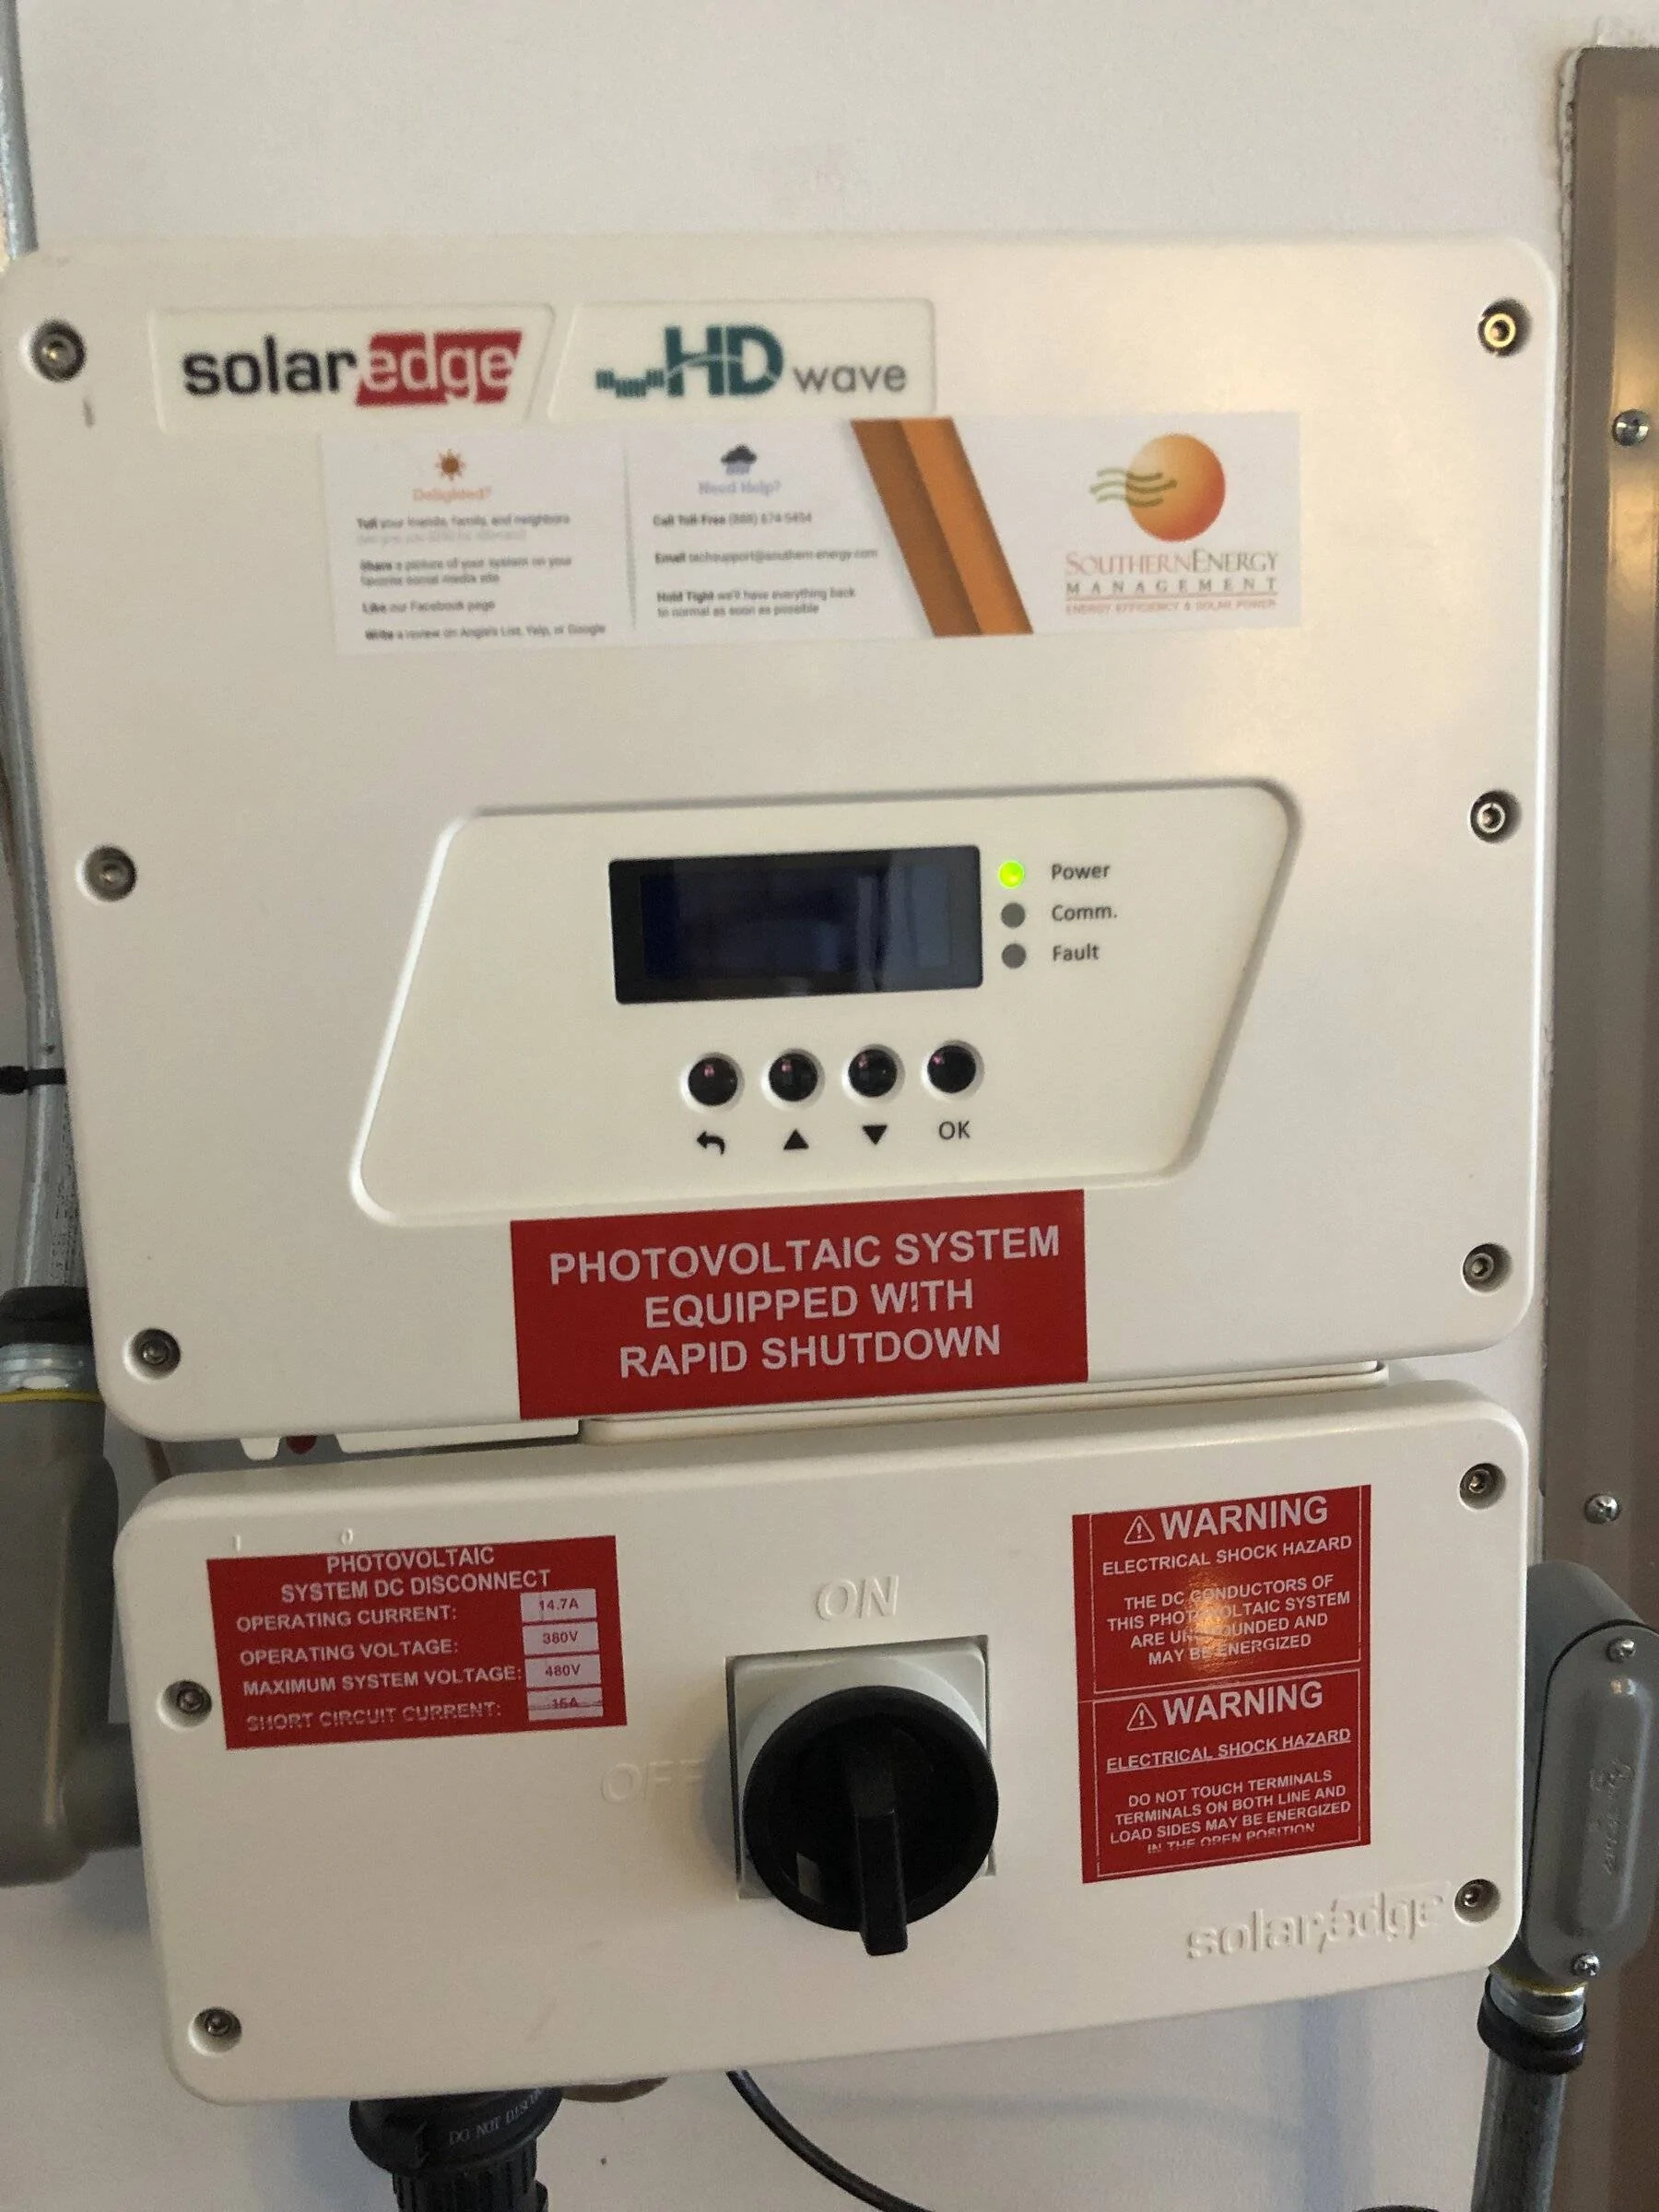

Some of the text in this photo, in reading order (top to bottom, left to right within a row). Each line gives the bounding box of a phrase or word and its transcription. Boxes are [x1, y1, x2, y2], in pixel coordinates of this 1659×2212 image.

[182, 332, 522, 403] solaredge
[664, 323, 907, 397] HD wave
[699, 479, 782, 497] Need Help?
[381, 519, 404, 530] your
[490, 514, 512, 527] and
[653, 513, 675, 526] Call
[446, 558, 458, 570] of
[655, 551, 686, 564] Email
[657, 591, 683, 603] Hold
[688, 590, 713, 604] Tight
[744, 590, 769, 601] have
[772, 588, 827, 602] everything
[830, 587, 855, 599] back
[1065, 577, 1277, 595] MANAGEMENT
[410, 600, 464, 612] Facebook
[467, 600, 495, 613] page
[658, 604, 819, 618] to normal as soon as possible
[568, 623, 606, 638] Google
[1052, 863, 1111, 880] Power
[1052, 904, 1118, 922] Comm.
[1053, 942, 1100, 961] Fault
[938, 1120, 971, 1141] OK
[549, 1224, 1060, 1286] PHOTOVOLTAIC SYSTEM
[645, 1277, 974, 1330] EQUIPPED WITH
[619, 1324, 1001, 1379] RAPID SHUTDOWN
[1159, 1495, 1328, 1541] WARNING
[326, 1546, 495, 1574] PHOTOVOLTAIC
[1102, 1535, 1353, 1577] ELECTRICAL SHOCK HAZARD
[280, 1568, 551, 1604] SYSTEM DC DISCONNECT
[815, 1574, 900, 1622] ON
[1124, 1574, 1335, 1611] THE DC CONDUCTORS OF
[538, 1597, 580, 1612] 14.7A
[1107, 1615, 1145, 1632] THIS
[1285, 1590, 1351, 1611] SYSTEM
[236, 1605, 457, 1633] OPERATING CURRENT:
[1130, 1632, 1166, 1650] ARE
[1294, 1612, 1328, 1629] AND
[542, 1630, 579, 1645] 380V
[1148, 1633, 1312, 1666] MAY BE ENERGIZED
[240, 1639, 459, 1667] OPERATING VOLTAGE:
[242, 1665, 523, 1697] MAXIMUM SYSTEM VOLTAGE:
[545, 1663, 581, 1677] 480V
[246, 1700, 502, 1732] SHORT CIRCUIT CURRENT:
[1162, 1680, 1324, 1726] WARNING
[1107, 1728, 1352, 1773] ELECTRICAL SHOCK HAZARD
[1128, 1769, 1333, 1807] DO NOT TOUCH TERMINALS
[1114, 1783, 1347, 1826] TERMINALS ON BOTH LINE AND
[1110, 1800, 1351, 1845] LOAD SIDES MAY BE ENERGIZED
[449, 2127, 471, 2147] DO
